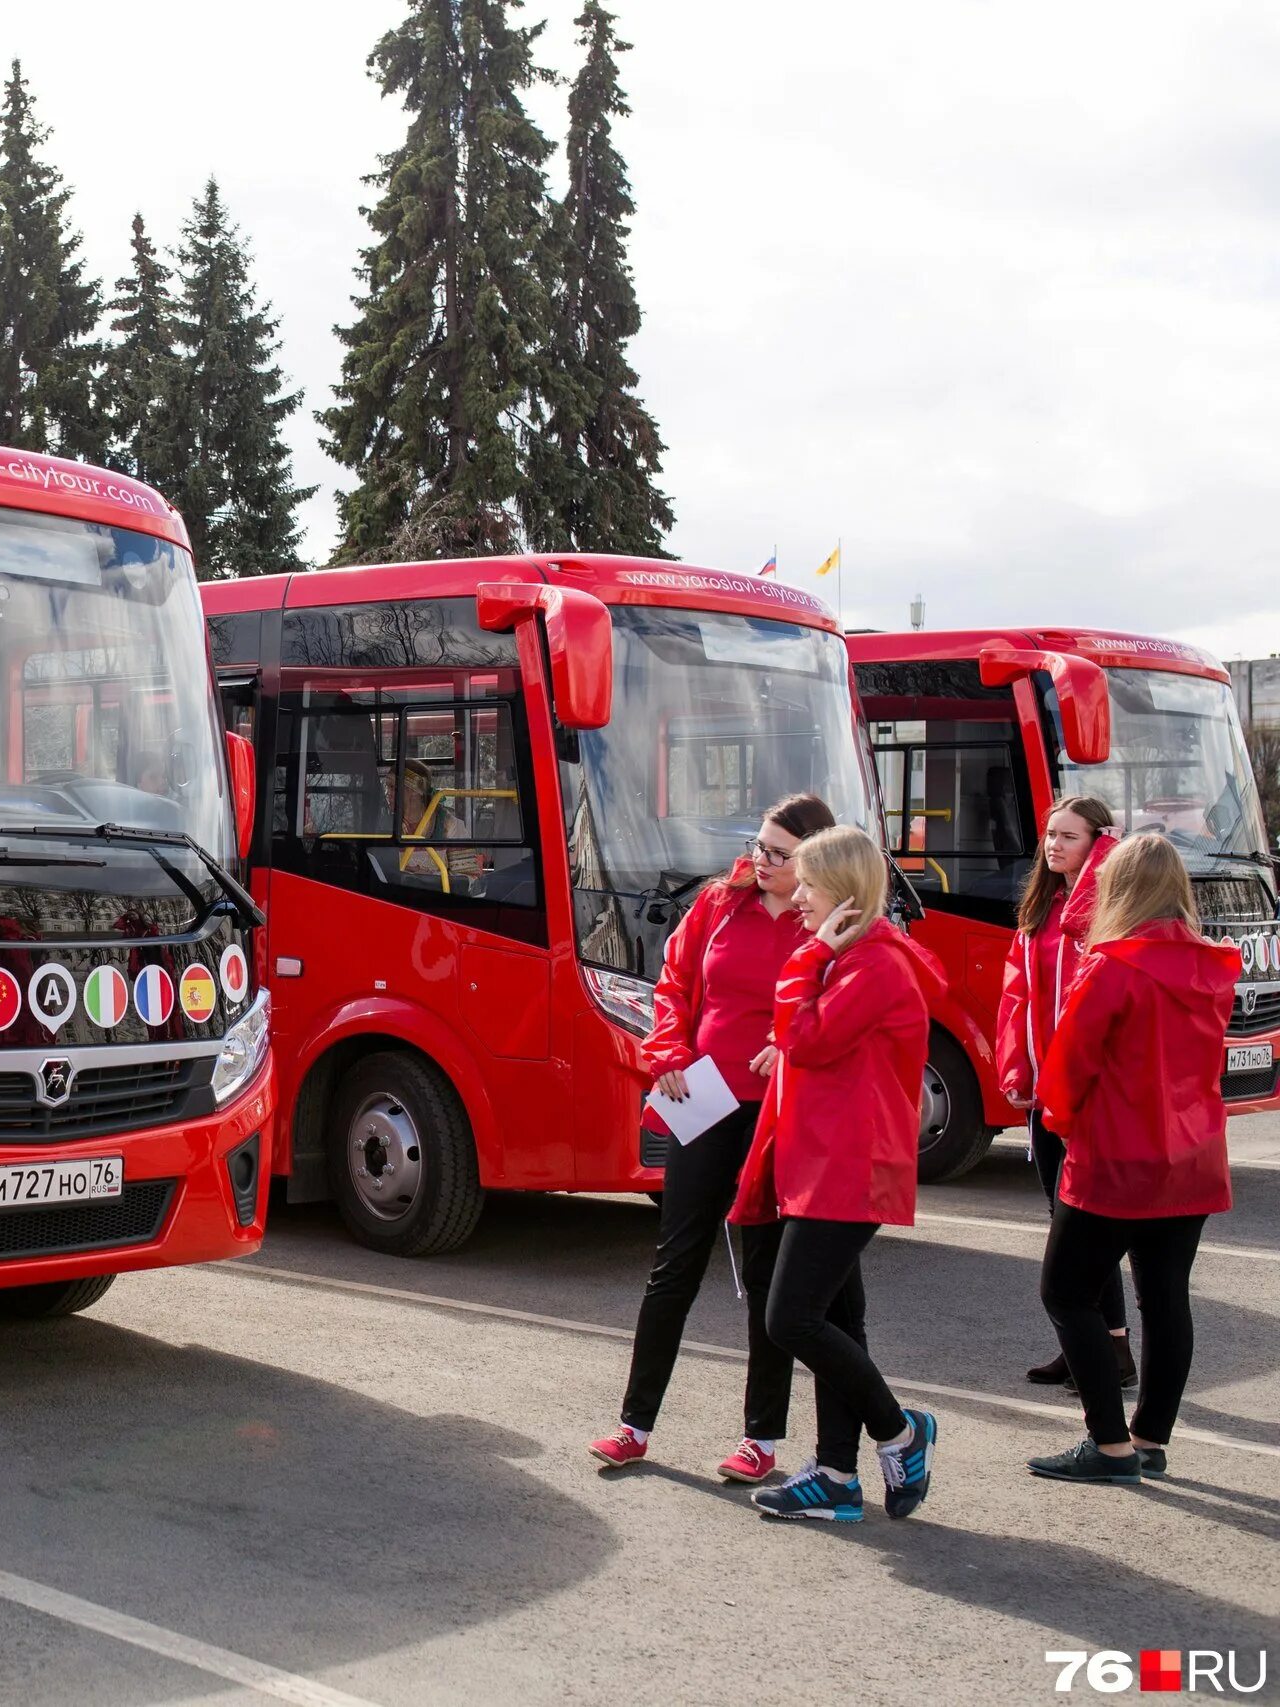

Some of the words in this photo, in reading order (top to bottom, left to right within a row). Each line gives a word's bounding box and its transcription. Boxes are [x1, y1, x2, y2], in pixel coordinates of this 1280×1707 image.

[627, 573, 824, 612] www.yaroslavl-citytour.co
[43, 979, 62, 1006] A
[93, 1163, 114, 1185] 76
[91, 1184, 107, 1194] RUS
